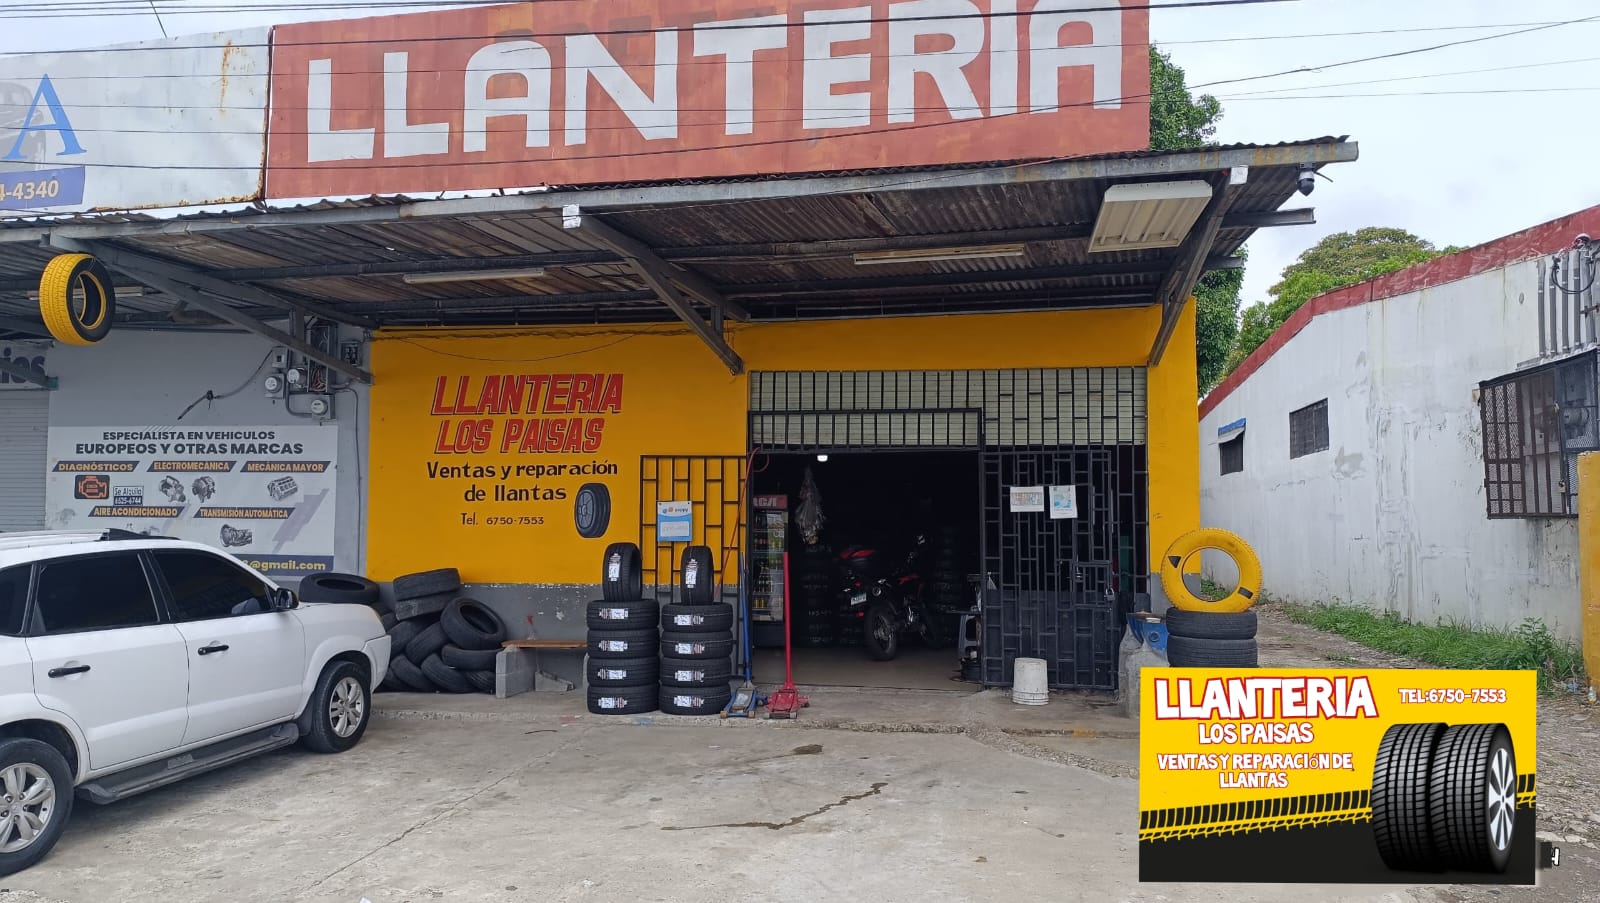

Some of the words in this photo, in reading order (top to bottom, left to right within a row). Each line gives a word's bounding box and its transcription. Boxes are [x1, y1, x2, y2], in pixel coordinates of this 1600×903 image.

[307, 0, 1122, 162] LLANTERIA
[431, 374, 624, 415] LLANTERIA
[103, 431, 185, 440] ESPECIALISTA
[187, 431, 203, 440] EN
[205, 431, 275, 440] VEHICULOS
[434, 419, 494, 454] LOS
[500, 418, 605, 454] PAISAS
[76, 443, 157, 454] EUROPEOS
[160, 443, 171, 454] Y
[174, 443, 228, 454] OTRAS
[230, 443, 303, 454] MARCAS
[58, 462, 134, 471] DIAGNÓSTICOS
[293, 463, 323, 472] MAYOR
[427, 461, 496, 478] Ventas
[500, 465, 512, 480] y
[516, 460, 618, 478] reparación
[464, 484, 486, 501] de
[495, 484, 567, 501] llantas
[93, 507, 111, 516] AIRE
[112, 507, 178, 517] ACONDICIONADO
[461, 512, 478, 526] Tel.
[486, 517, 544, 525] 6750-7553
